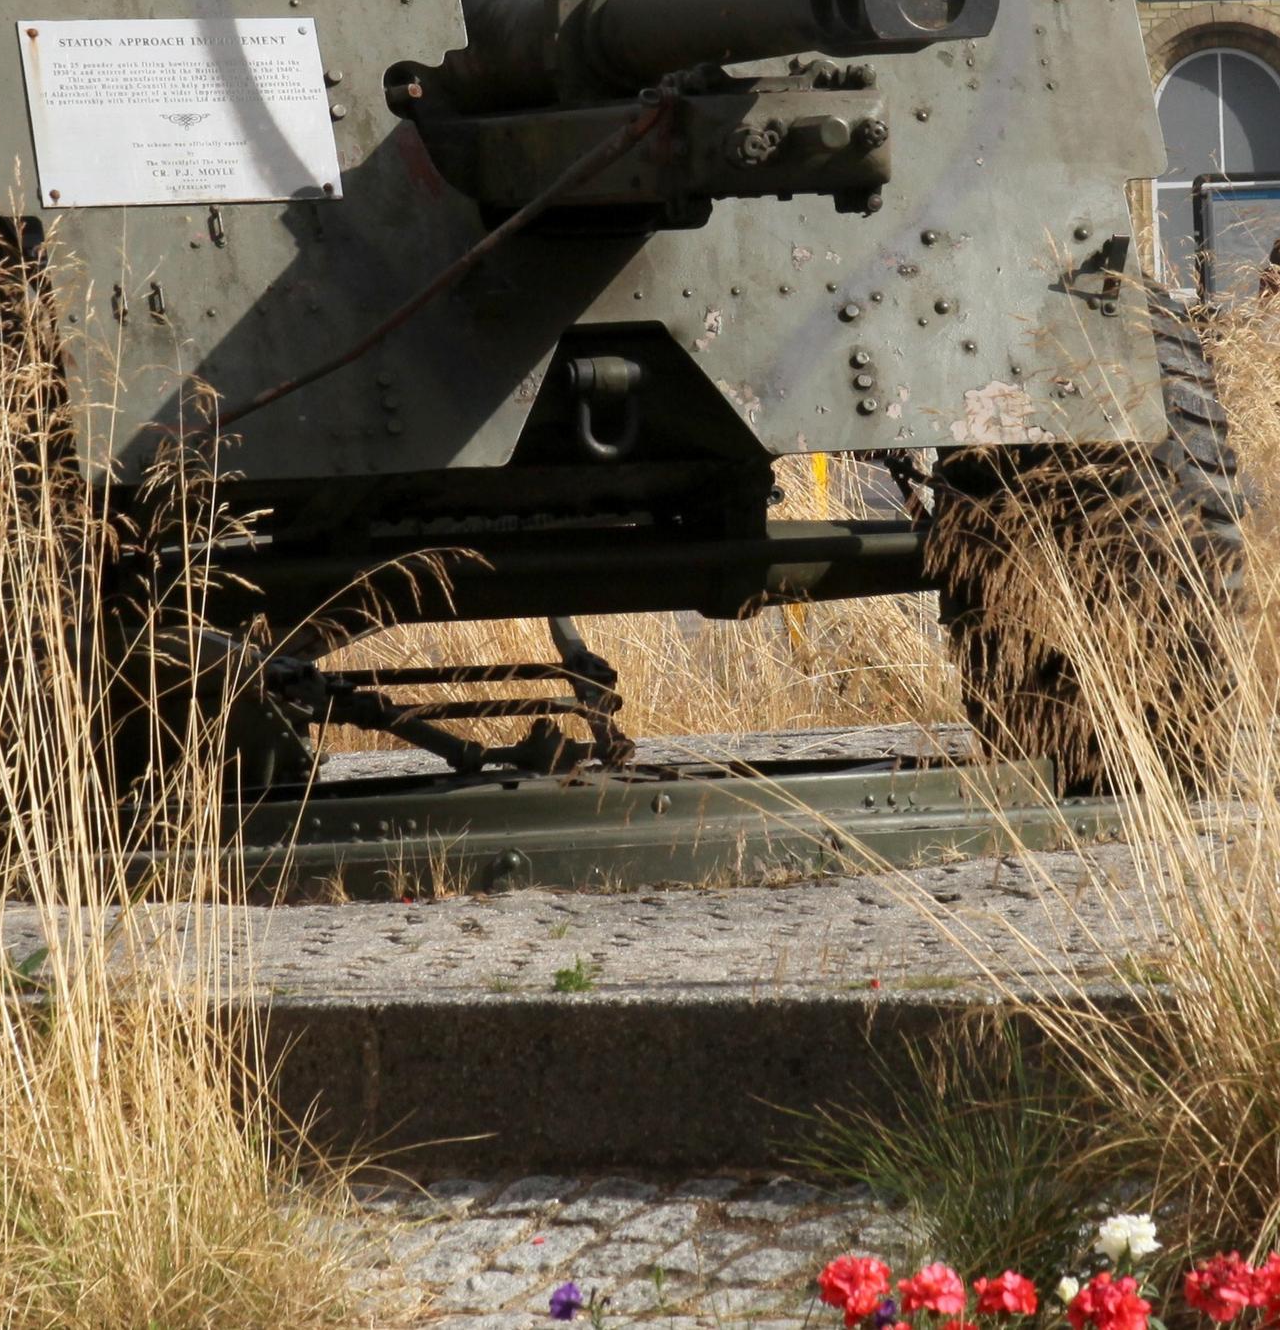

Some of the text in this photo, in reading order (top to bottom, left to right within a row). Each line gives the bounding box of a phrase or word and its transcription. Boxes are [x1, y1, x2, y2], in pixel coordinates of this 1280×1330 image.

[58, 37, 112, 47] STATION
[119, 37, 184, 47] APPROACH
[83, 62, 113, 70] pounder
[117, 61, 138, 69] quick
[101, 83, 134, 91] Borough
[181, 82, 198, 90] help
[131, 90, 148, 98] part
[170, 89, 191, 97] wider
[278, 87, 306, 95] carried
[58, 98, 104, 107] partnership
[131, 141, 144, 149] The
[188, 140, 221, 148] officially
[224, 140, 248, 148] opened
[161, 158, 199, 167] Worshipful
[217, 157, 240, 166] Mayor
[151, 167, 235, 178] CR. P.J. MOYLE
